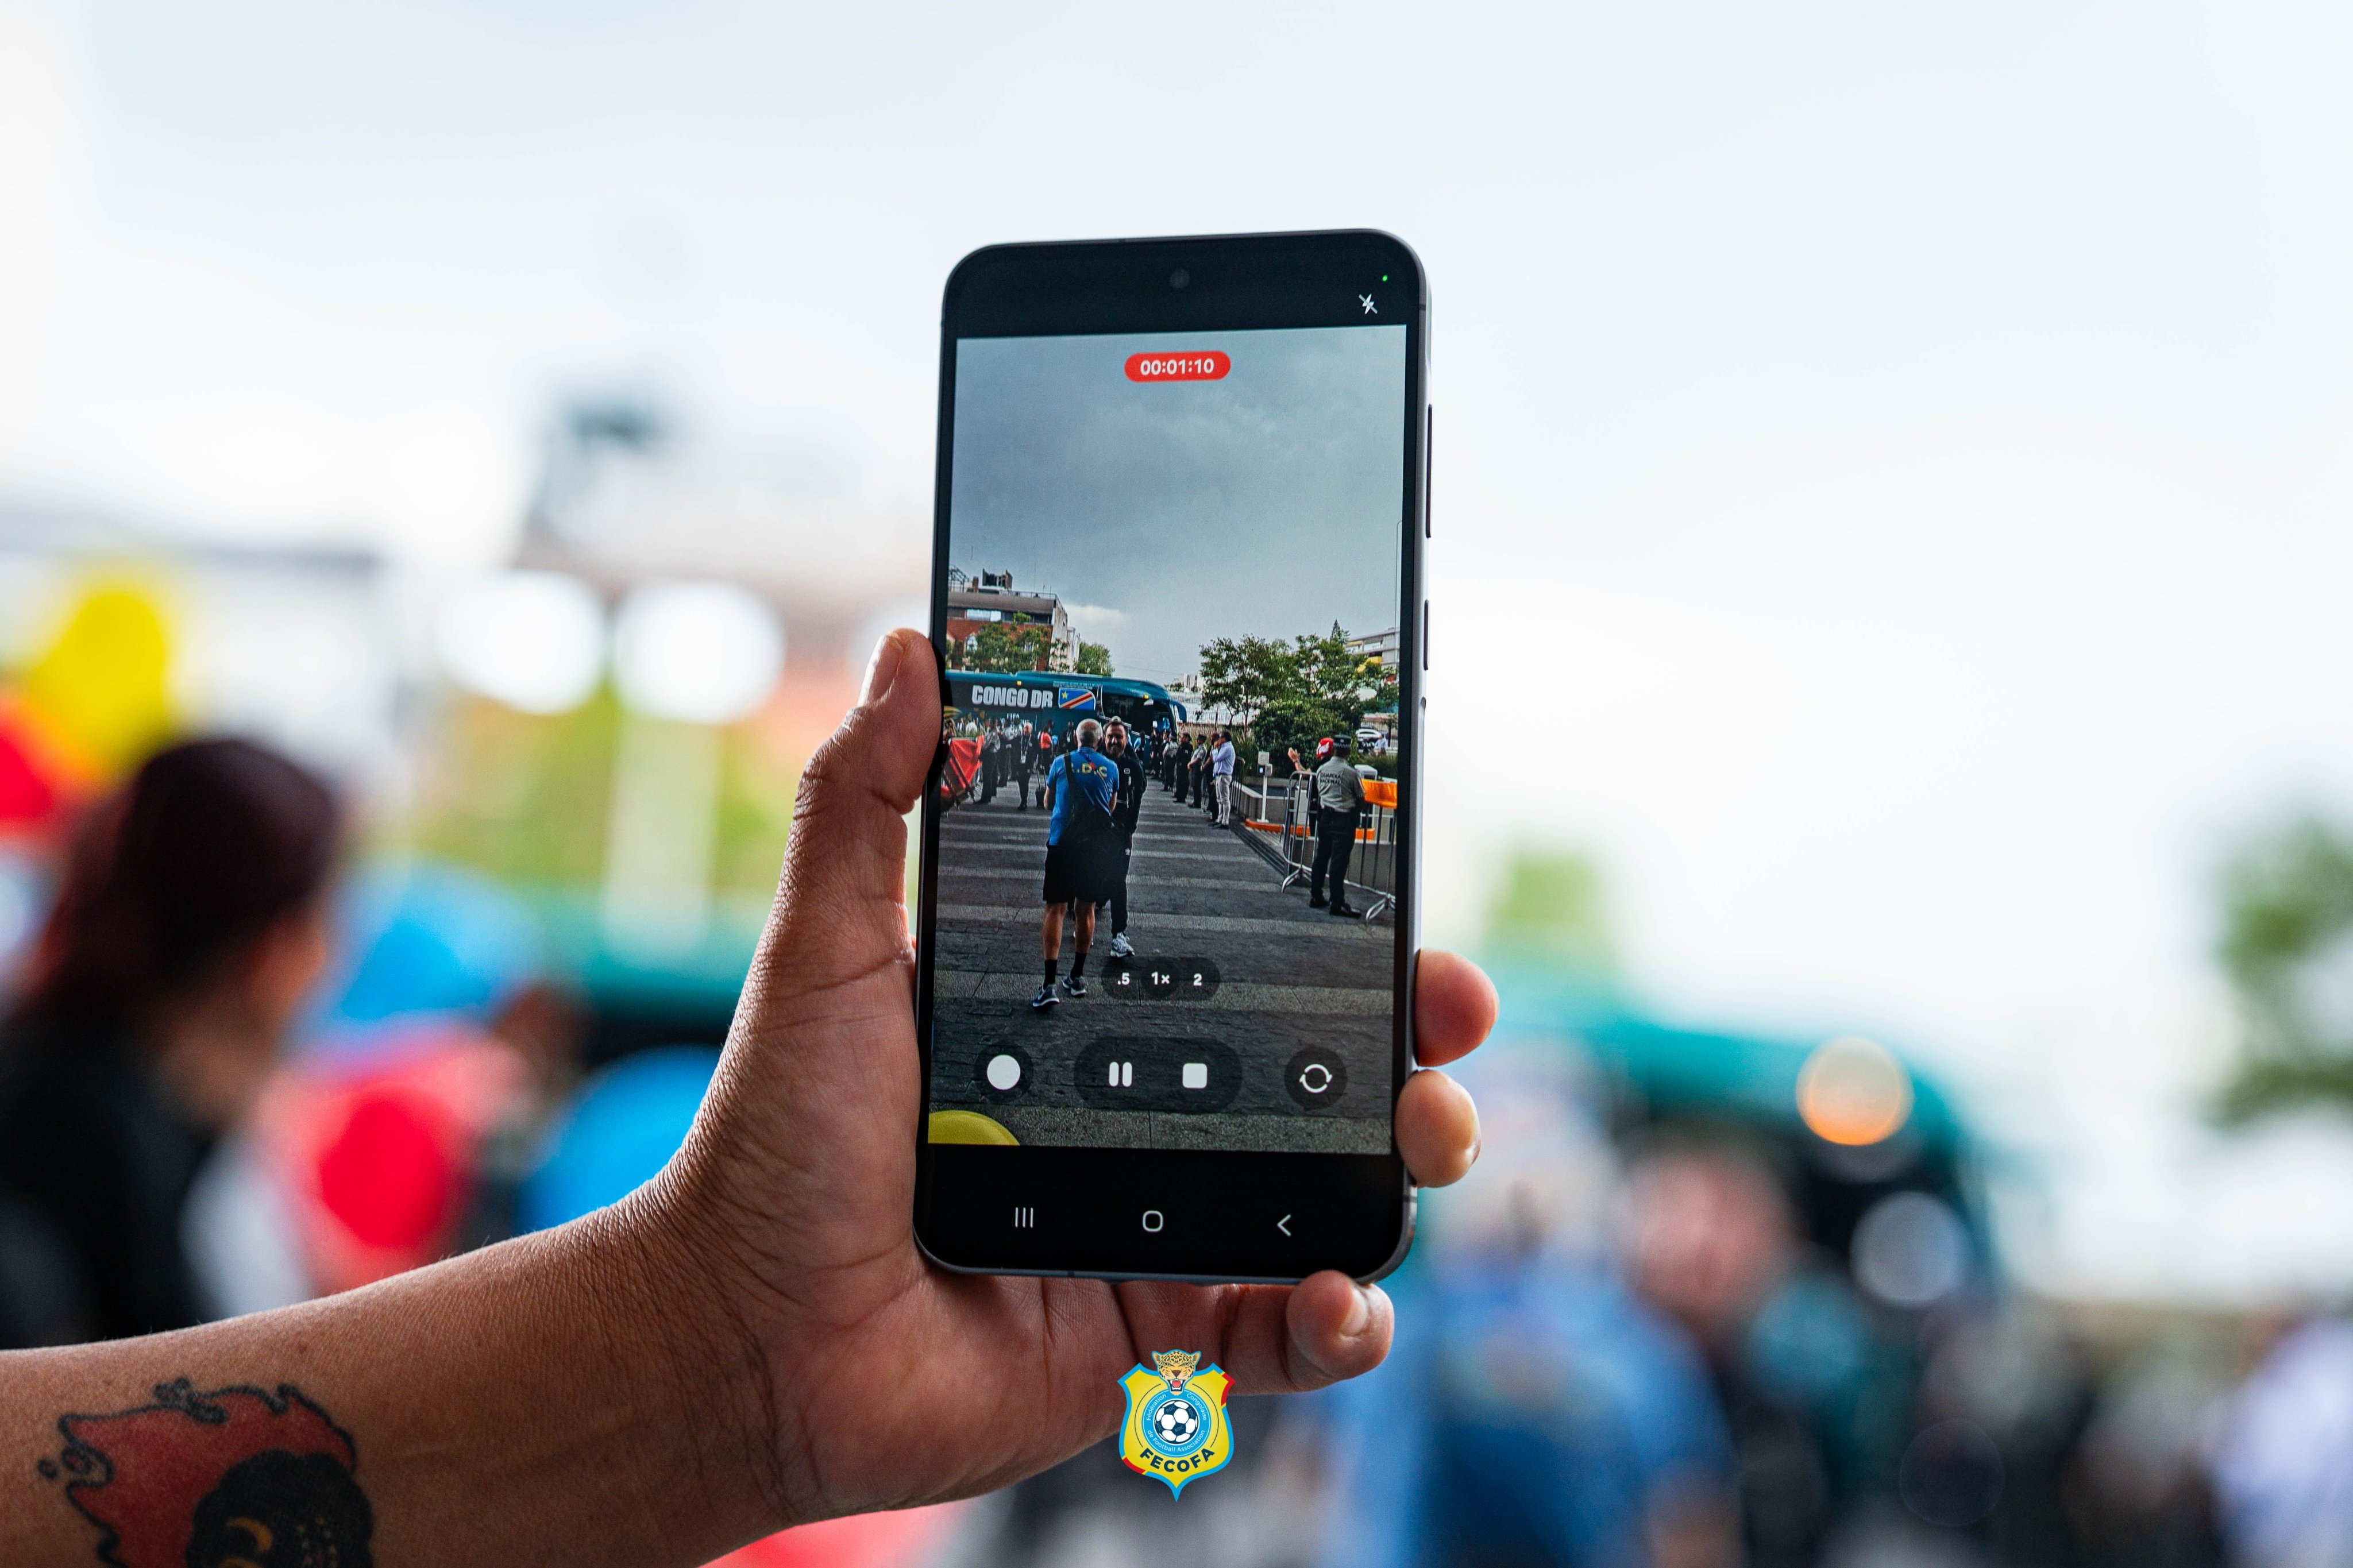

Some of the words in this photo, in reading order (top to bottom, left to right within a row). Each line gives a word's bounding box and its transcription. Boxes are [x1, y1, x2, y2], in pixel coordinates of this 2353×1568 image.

[1140, 358, 1214, 376] 00:01:10
[971, 685, 1028, 708] CONGO
[1030, 690, 1054, 709] DR
[1117, 972, 1130, 985] .5
[1193, 973, 1202, 986] 2
